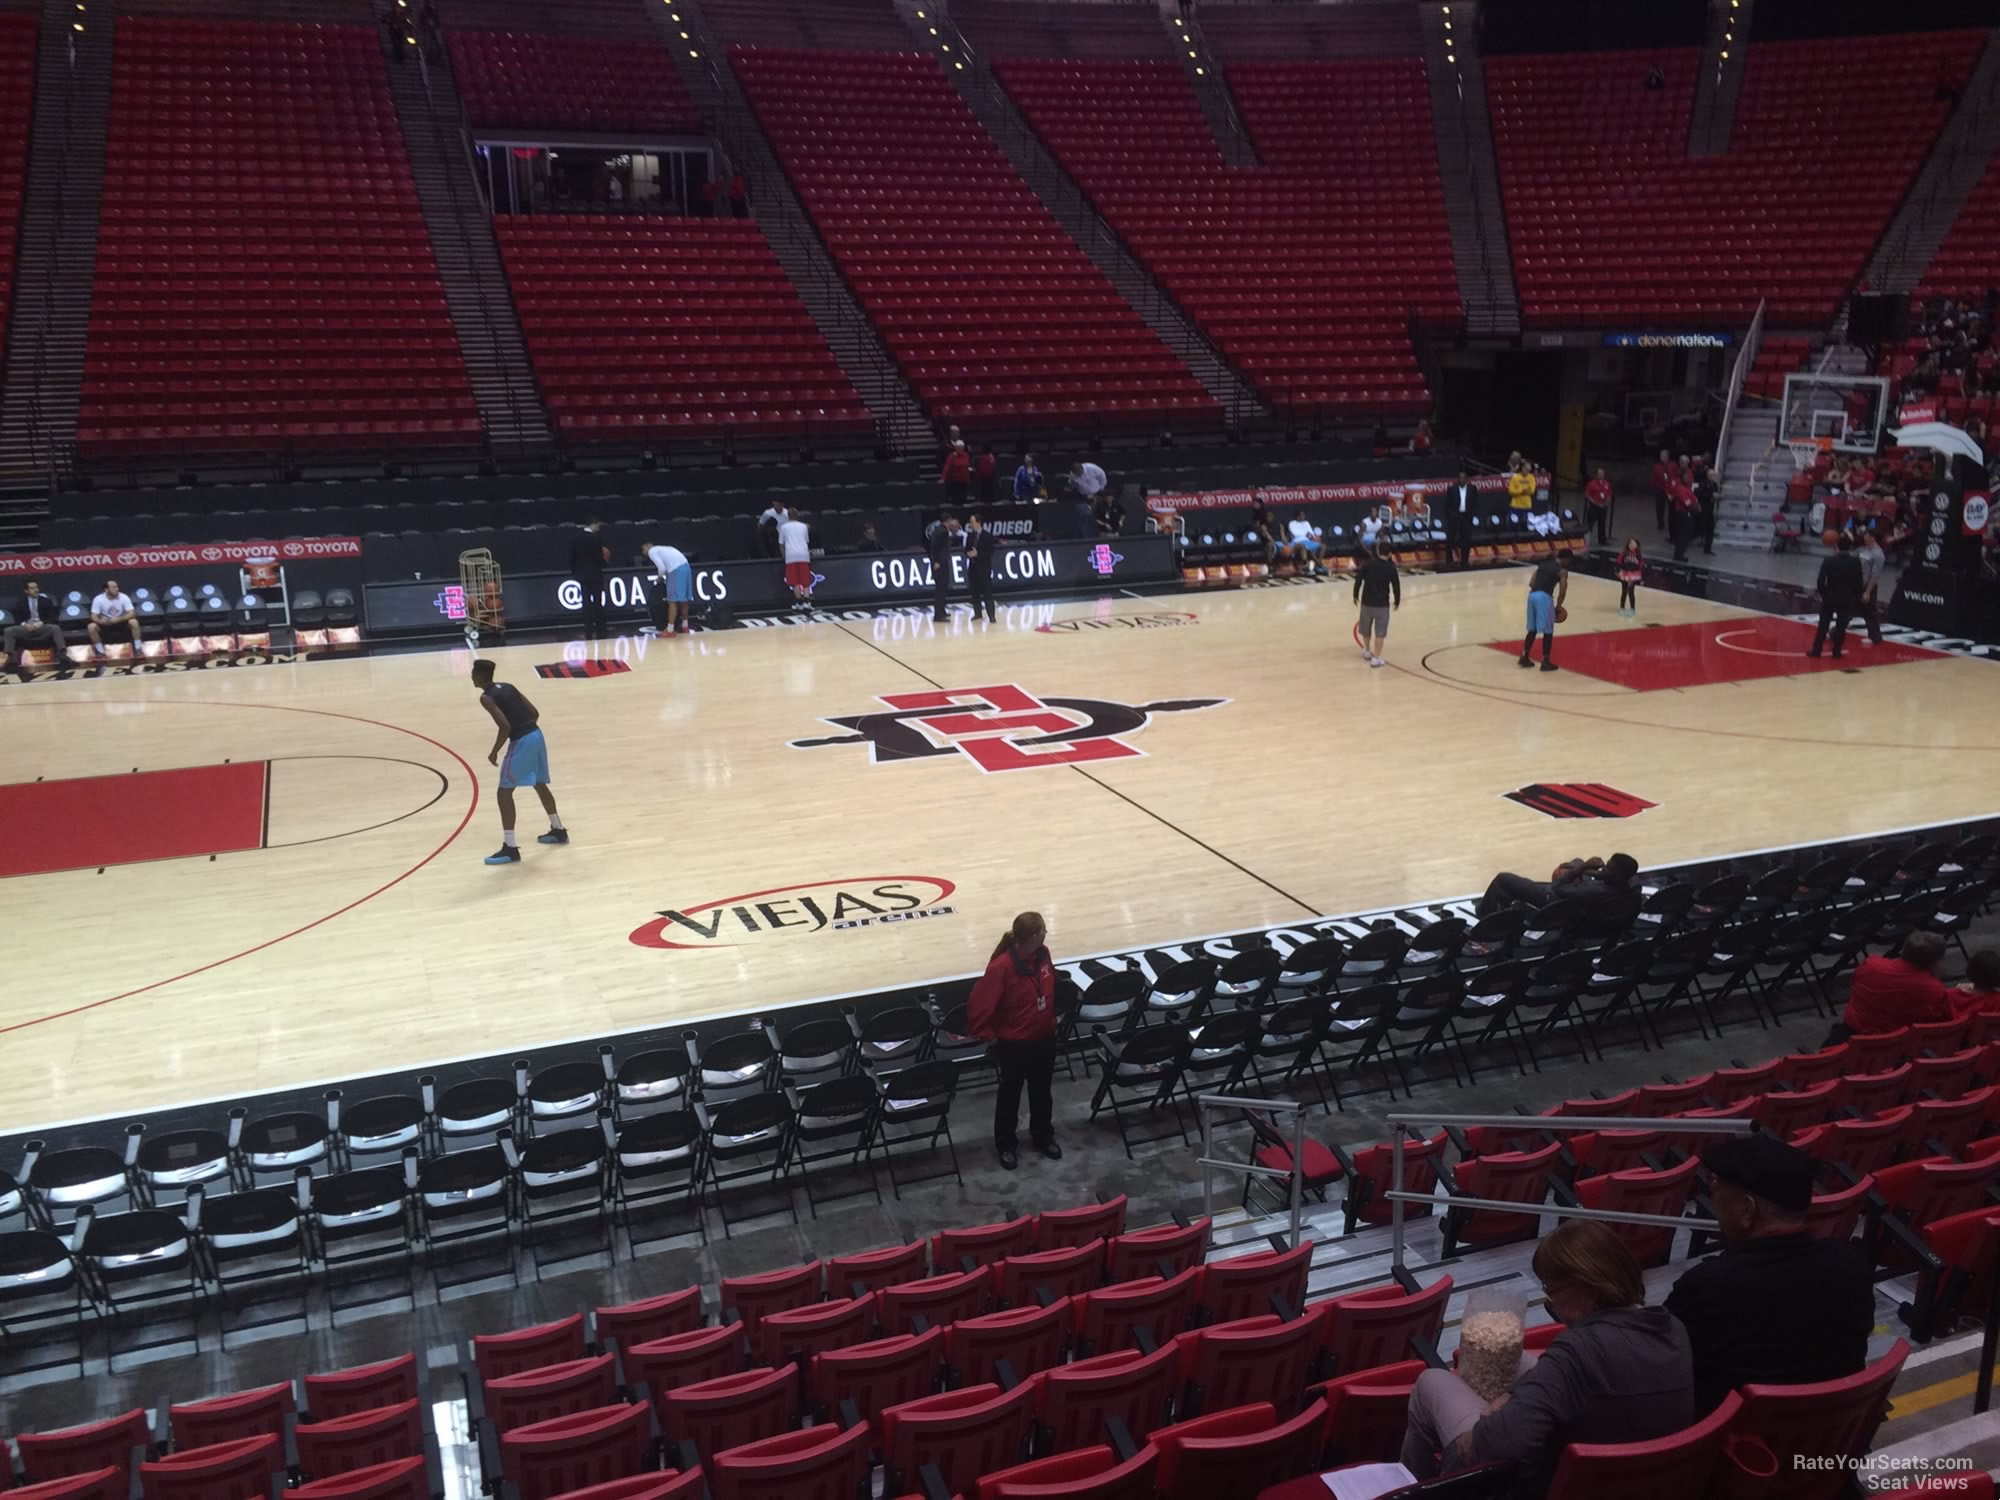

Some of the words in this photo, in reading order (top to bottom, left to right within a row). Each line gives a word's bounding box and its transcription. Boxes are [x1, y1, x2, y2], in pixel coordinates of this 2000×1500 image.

[1215, 494, 1252, 504] TOYOTA
[1268, 491, 1305, 501] TOYOTA
[1322, 488, 1355, 498] TOYOTA
[1161, 498, 1199, 508] TOYOTA
[992, 519, 1033, 536] DIEGO
[223, 545, 280, 558] TOYOTA
[305, 541, 360, 554] TOYOTA
[54, 554, 113, 567] TOYOTA
[139, 550, 198, 563] TOYOTA
[871, 549, 1056, 590] GOAZE.COM
[1903, 589, 1945, 606] vw.com
[654, 884, 921, 939] VIEJAS
[831, 905, 958, 931] arena
